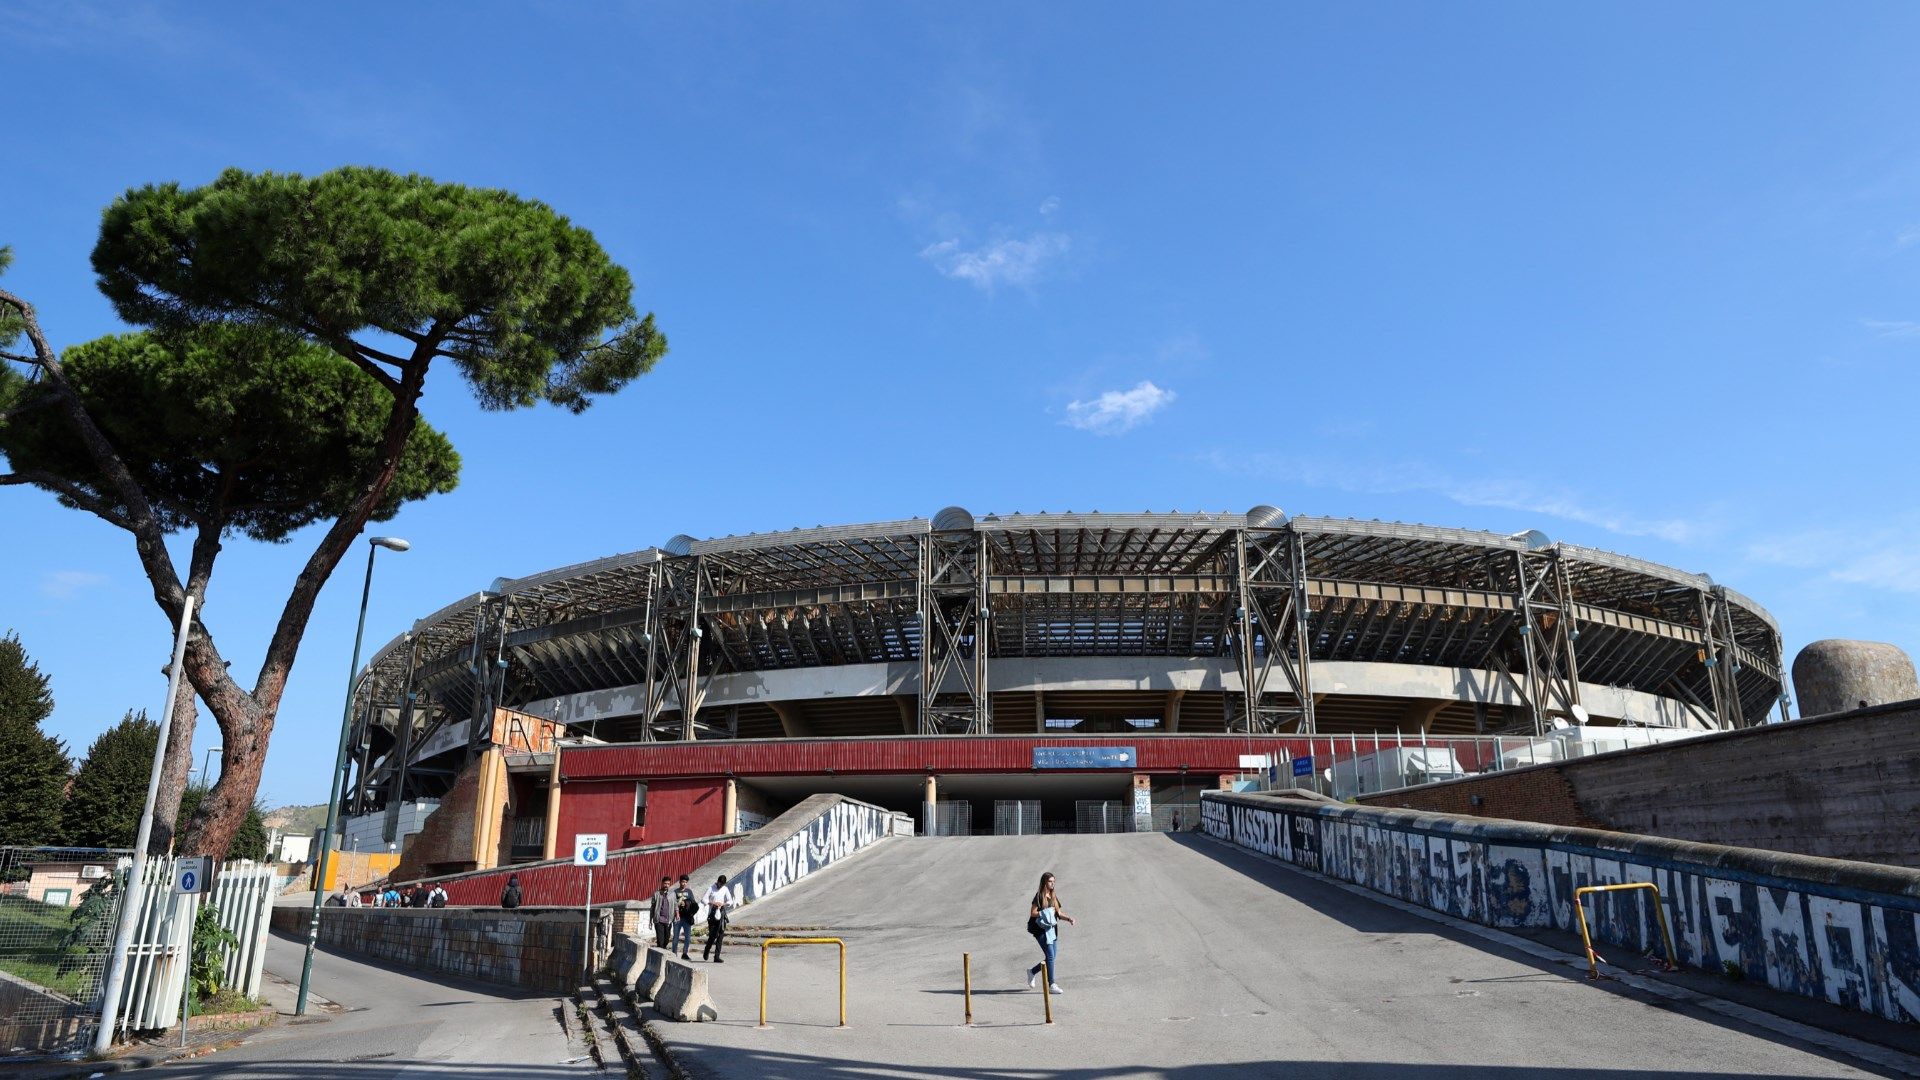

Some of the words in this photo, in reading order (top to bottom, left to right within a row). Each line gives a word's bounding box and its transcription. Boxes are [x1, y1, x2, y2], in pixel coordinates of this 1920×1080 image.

[753, 831, 808, 898] CURVA
[829, 802, 877, 862] NAPOLI
[1232, 805, 1293, 862] MASSERIA
